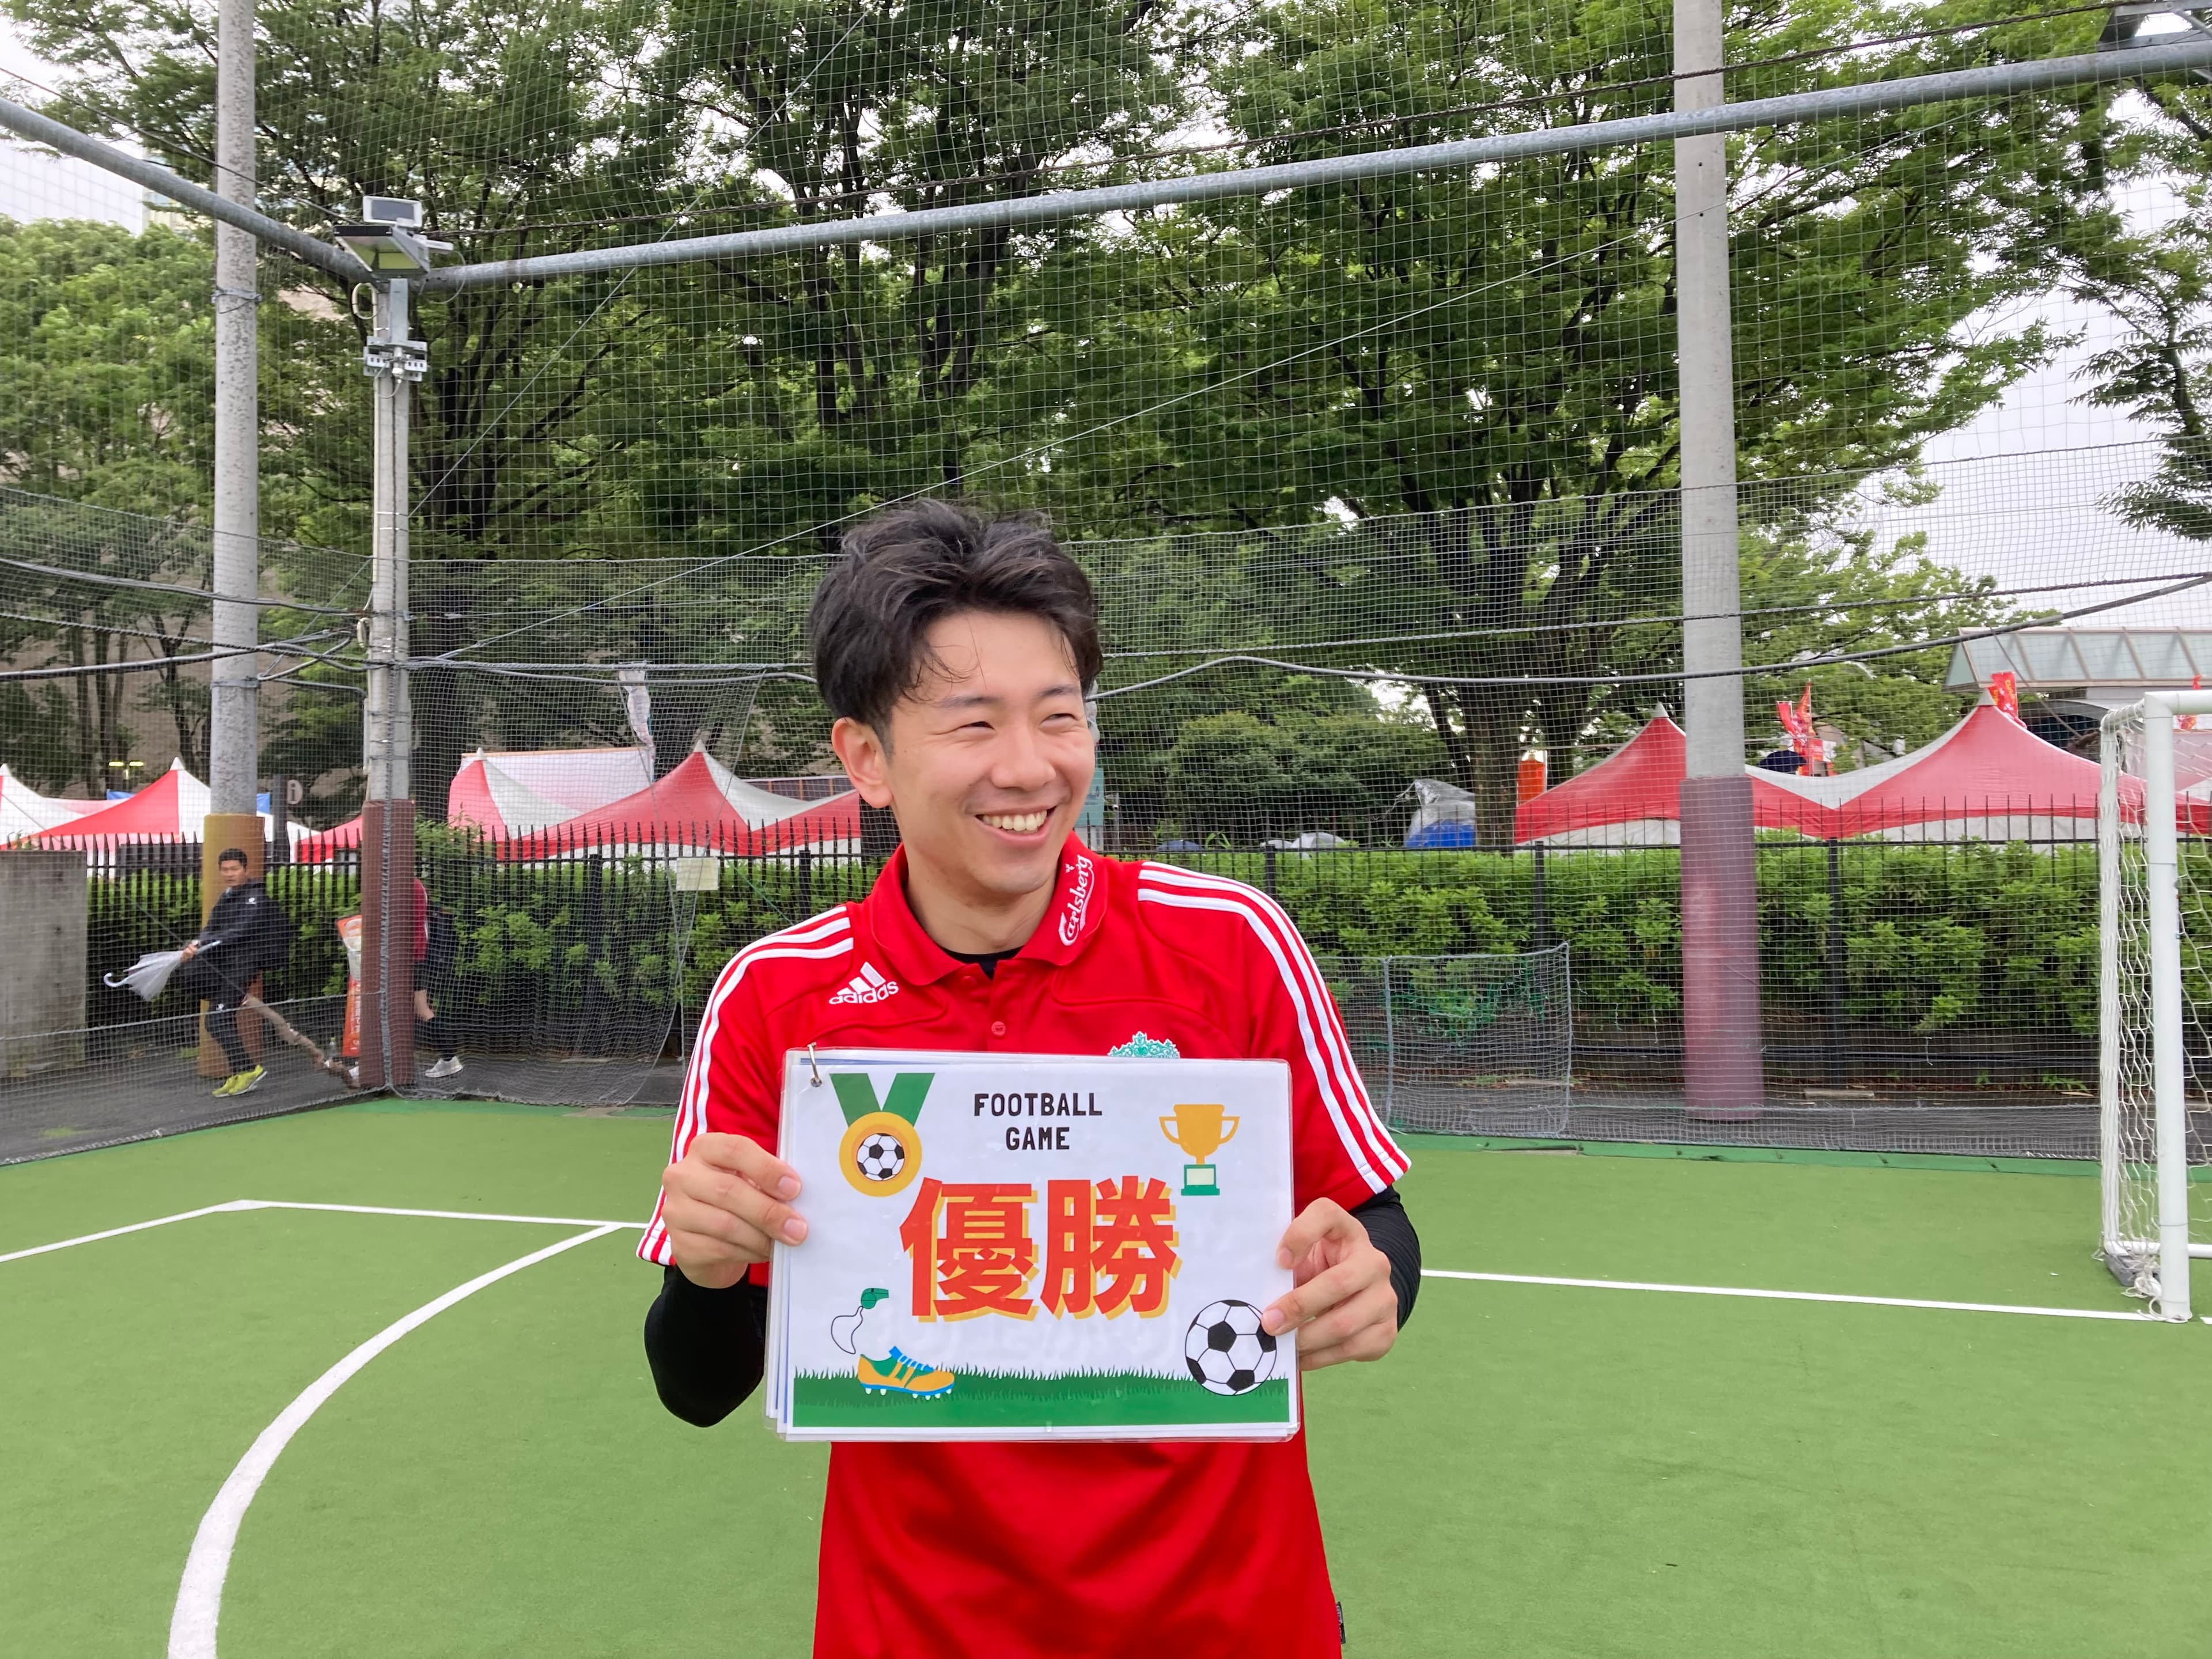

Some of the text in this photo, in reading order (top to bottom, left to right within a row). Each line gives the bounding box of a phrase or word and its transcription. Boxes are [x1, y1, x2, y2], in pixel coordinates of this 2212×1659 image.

[1059, 854, 1094, 946] Carlsberg
[829, 981, 899, 1004] adidas
[974, 1093, 1103, 1116] FOOTBALL
[1006, 1127, 1070, 1150] GAME
[900, 1175, 1181, 1323] 優勝
